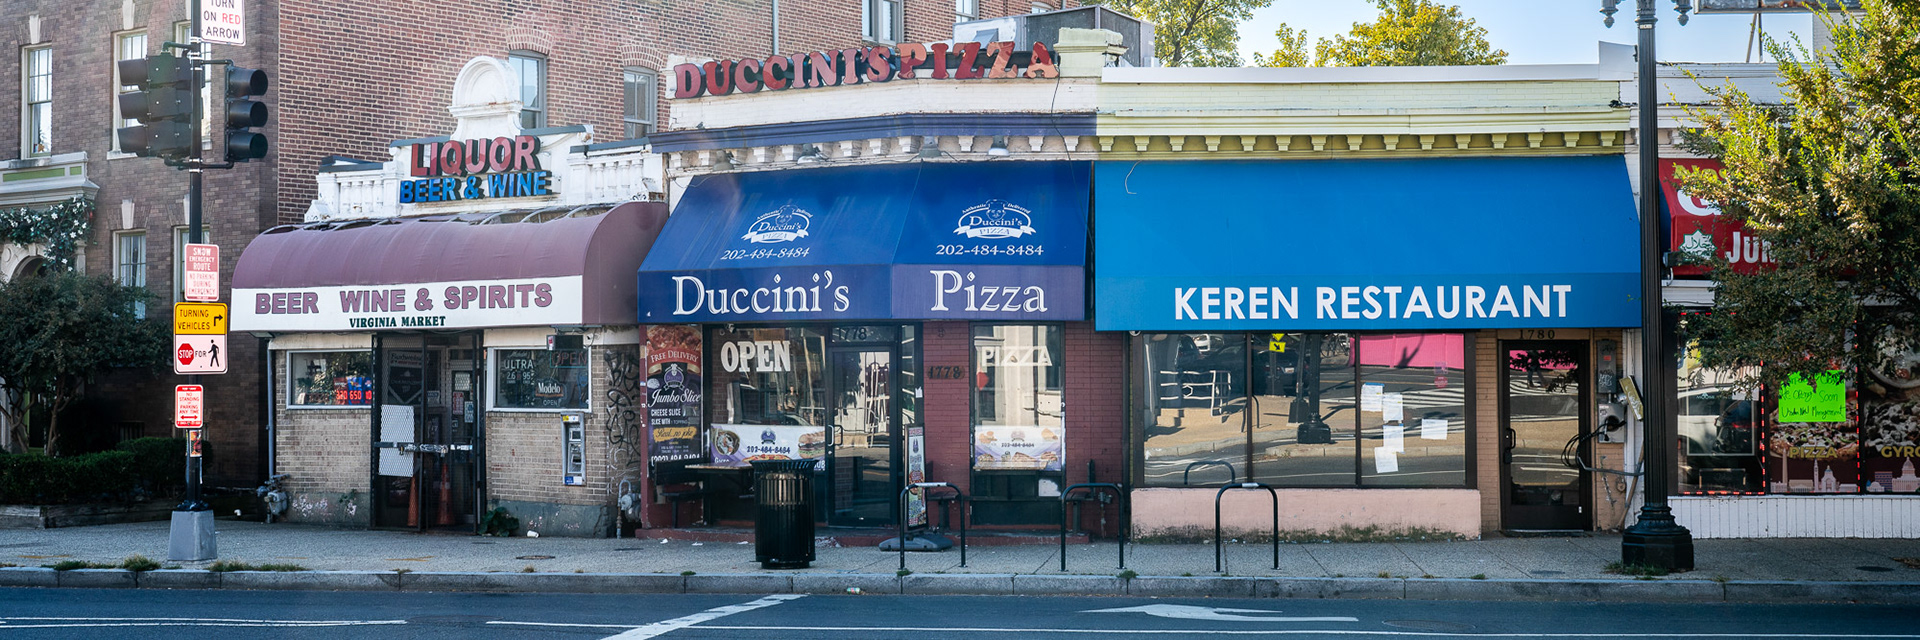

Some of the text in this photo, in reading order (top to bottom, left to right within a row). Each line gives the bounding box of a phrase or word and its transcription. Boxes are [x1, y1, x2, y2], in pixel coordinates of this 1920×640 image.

[203, 10, 241, 25] ON RED
[206, 26, 240, 39] ARROW
[674, 41, 1059, 99] DUCCINI'S PIZZA
[411, 135, 540, 177] LIQUOR
[400, 171, 552, 203] BEER & WINE
[1007, 203, 1031, 214] Delivered
[757, 221, 801, 231] Duccini's
[969, 215, 1022, 226] Duccini's
[193, 247, 211, 256] SNOW
[720, 247, 810, 260] 202-484-8484
[935, 244, 1044, 256] 202-484-8484
[193, 262, 211, 270] ROUTE
[255, 283, 553, 315] BEER WINE & SPIRITS
[672, 269, 1048, 316] Duccini's Pizza
[1175, 284, 1572, 320] KEREN RESTAURANT
[180, 309, 209, 318] TURNING
[177, 321, 210, 330] VEHICLES
[349, 315, 446, 328] VIRGINIA MARKET
[1519, 330, 1555, 339] 1780
[178, 349, 194, 359] STOP
[550, 351, 587, 366] OPEN
[650, 350, 699, 363] FREE DELIVERY
[720, 340, 791, 373] OPEN
[981, 345, 1053, 367] PIZZA
[503, 359, 534, 369] ULTRA
[927, 366, 961, 379] 1778
[538, 382, 561, 394] Modelo
[349, 390, 362, 400] 650
[647, 389, 701, 408] Jumbo Slice
[1818, 389, 1839, 404] Soon
[651, 408, 681, 417] CHEESE SLICE
[746, 445, 791, 454] 202-484-8484
[1789, 446, 1838, 458] PIZZA
